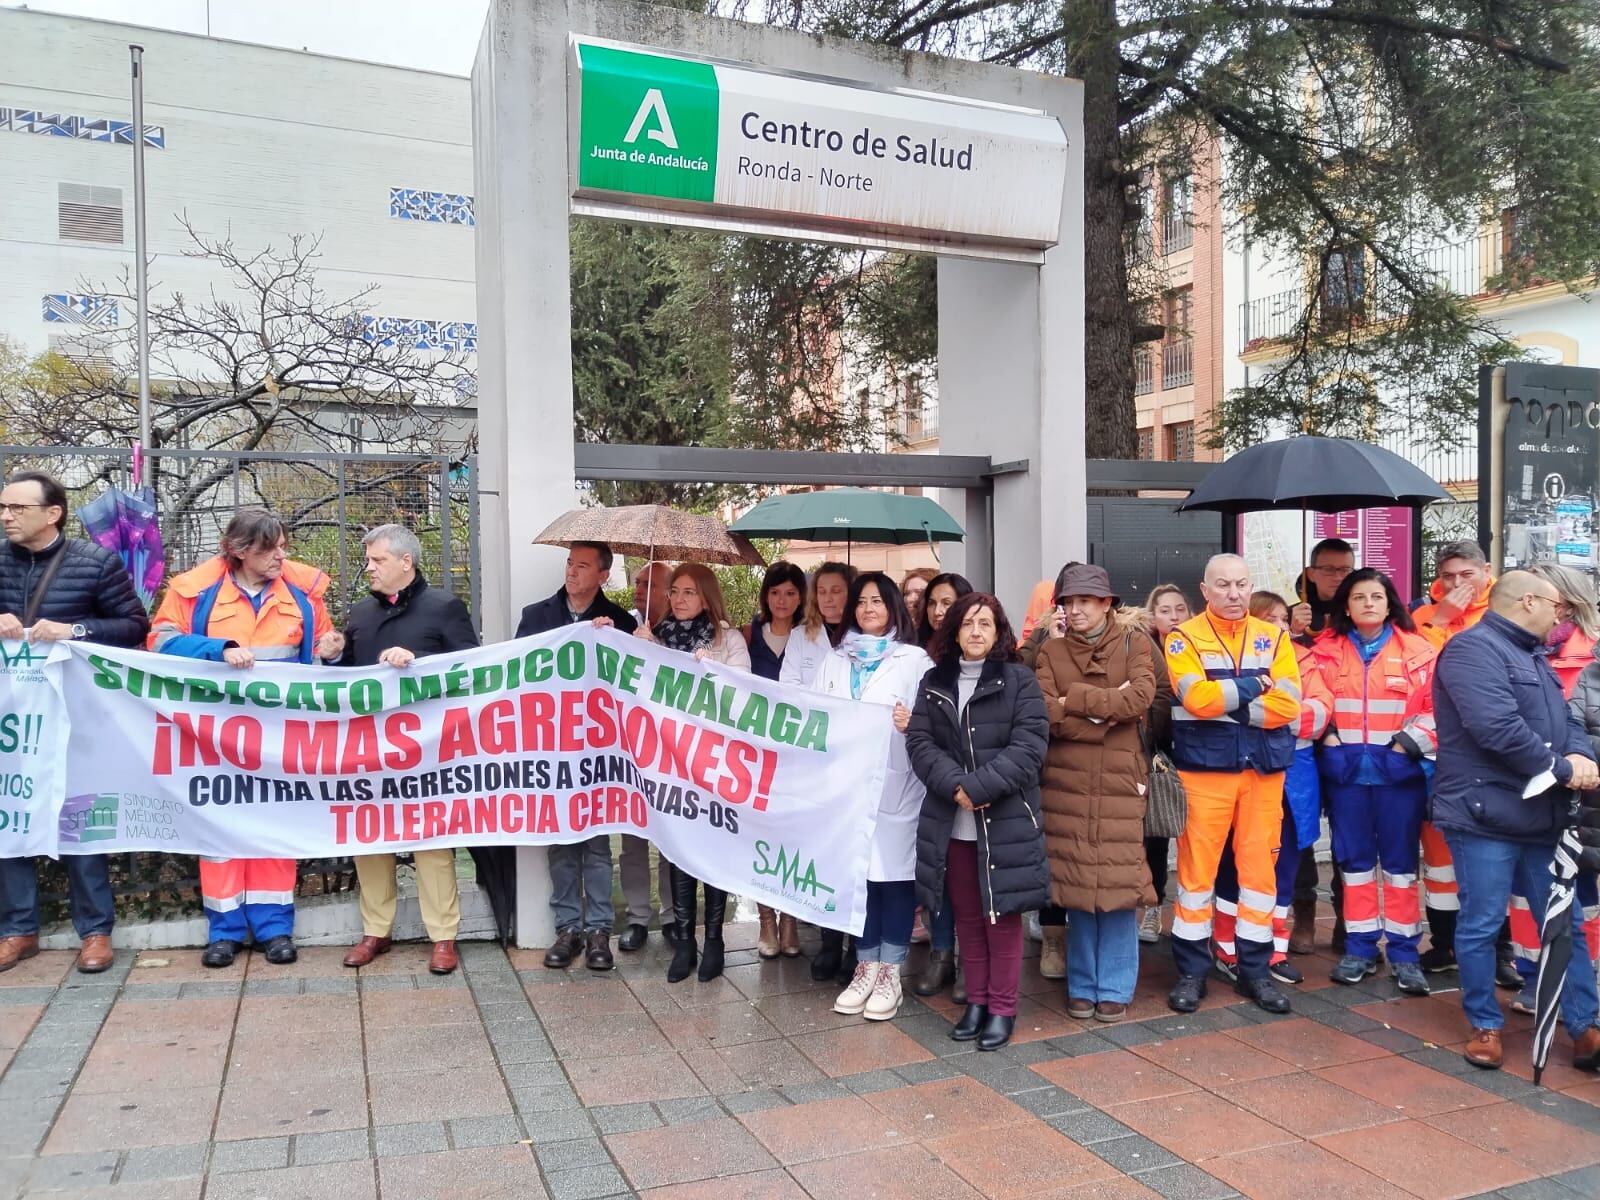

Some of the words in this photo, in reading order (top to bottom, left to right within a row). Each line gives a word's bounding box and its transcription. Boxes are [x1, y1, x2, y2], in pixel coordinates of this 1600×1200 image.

[590, 145, 627, 161] Junta
[629, 149, 646, 163] de
[647, 152, 709, 171] Andalucía
[740, 111, 844, 152] Centro
[852, 127, 887, 158] de
[895, 134, 975, 171] Salud
[738, 155, 802, 183] Ronda
[819, 167, 873, 192] Norte
[88, 654, 383, 715] SINDICATO
[399, 640, 586, 701] MÉDICO
[595, 642, 646, 695] DE
[650, 664, 829, 752] MÁLAGA
[152, 712, 262, 775] ¡NO
[282, 712, 423, 776] MAS
[439, 688, 778, 812] AGRESIONES!
[0, 773, 33, 800] IOS
[123, 792, 184, 814] SINDICATO
[188, 775, 312, 807] CONTRA
[319, 779, 373, 802] LAS
[381, 759, 550, 800] AGRESIONES
[556, 761, 574, 790] A
[125, 808, 173, 825] MÉDICO
[125, 823, 180, 841] MÁLAGA
[330, 793, 559, 845] TOLERANCIA
[568, 787, 648, 832] CERO
[753, 840, 836, 897] SMA
